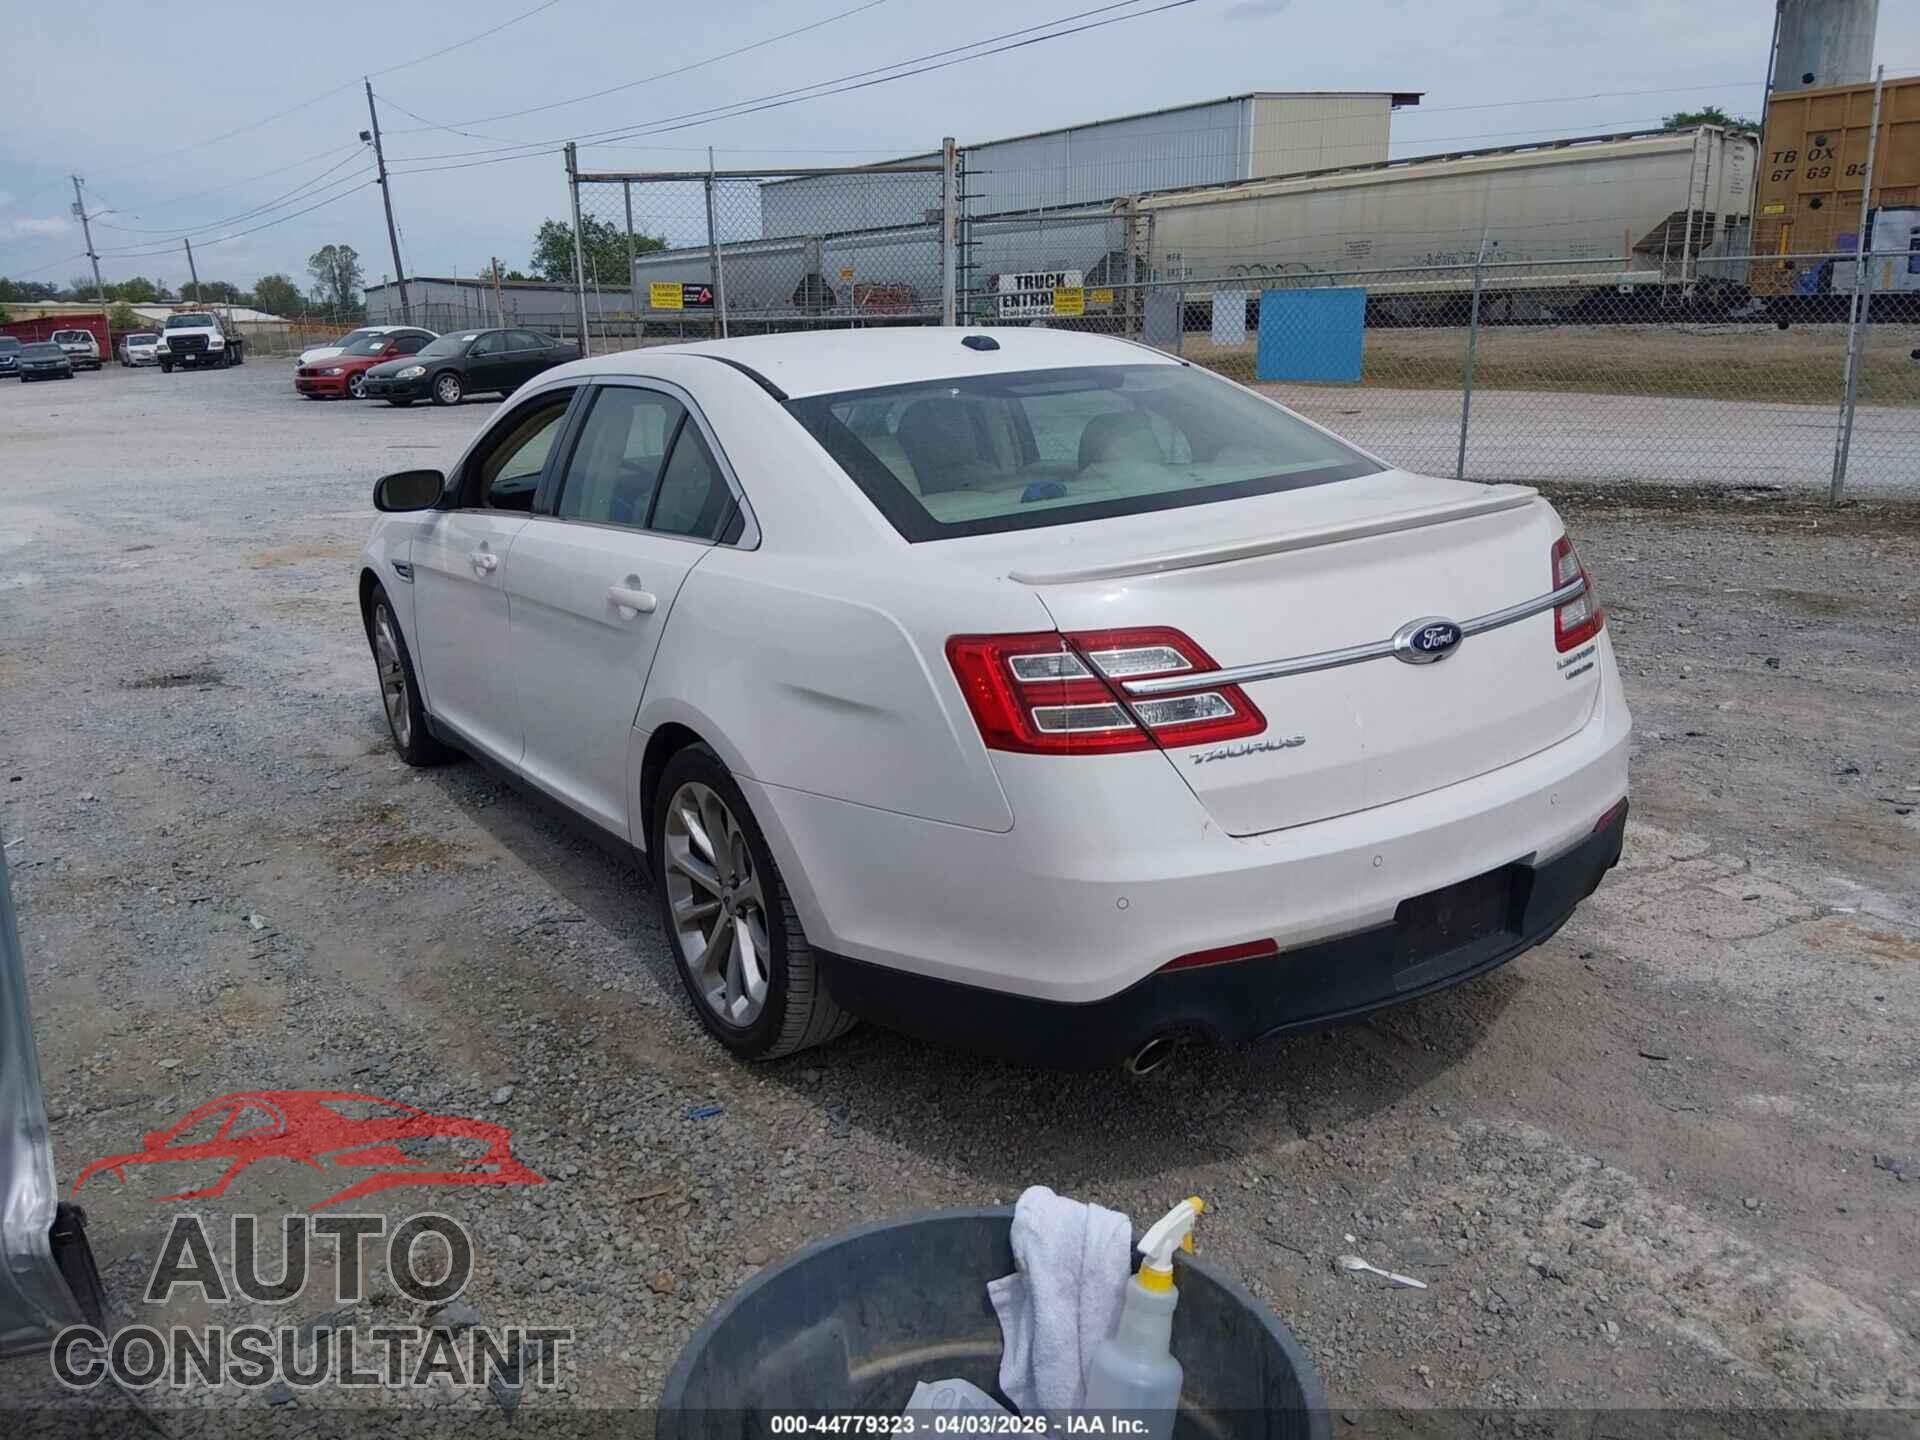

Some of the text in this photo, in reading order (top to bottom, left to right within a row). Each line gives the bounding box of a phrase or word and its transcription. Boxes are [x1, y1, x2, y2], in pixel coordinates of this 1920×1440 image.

[1014, 273, 1066, 290] TRUCK
[1002, 290, 1054, 308] ENTRA
[1423, 626, 1454, 649] Ford
[1189, 735, 1306, 765] TAURUS
